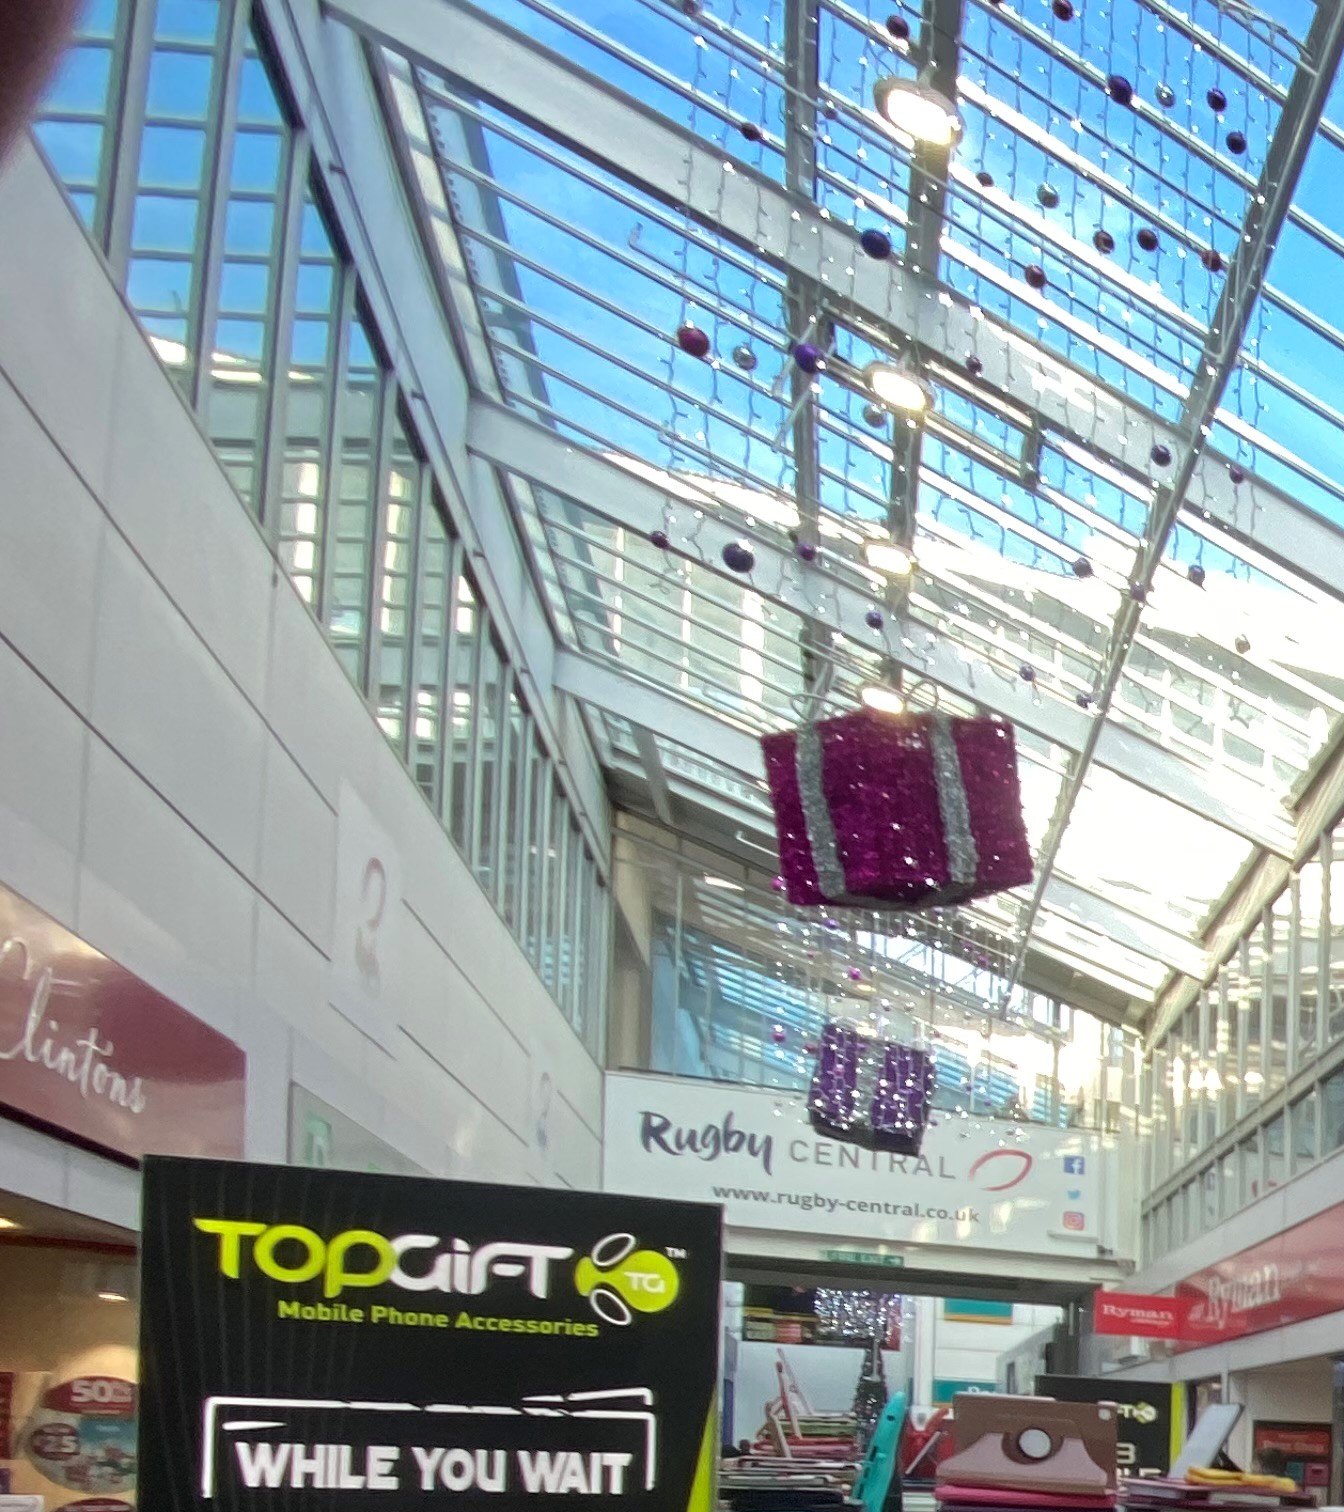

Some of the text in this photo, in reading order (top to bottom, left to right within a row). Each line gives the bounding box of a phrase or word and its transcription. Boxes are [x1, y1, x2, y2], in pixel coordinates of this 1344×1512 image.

[639, 1111, 956, 1180] Rugby CENTRAL
[713, 1184, 980, 1224] www.rugby-central.co.uk
[278, 1299, 599, 1338] Mobile Phone Accessories
[1102, 1303, 1174, 1321] Ryman
[235, 1442, 633, 1495] WHILE YOU WAIT
